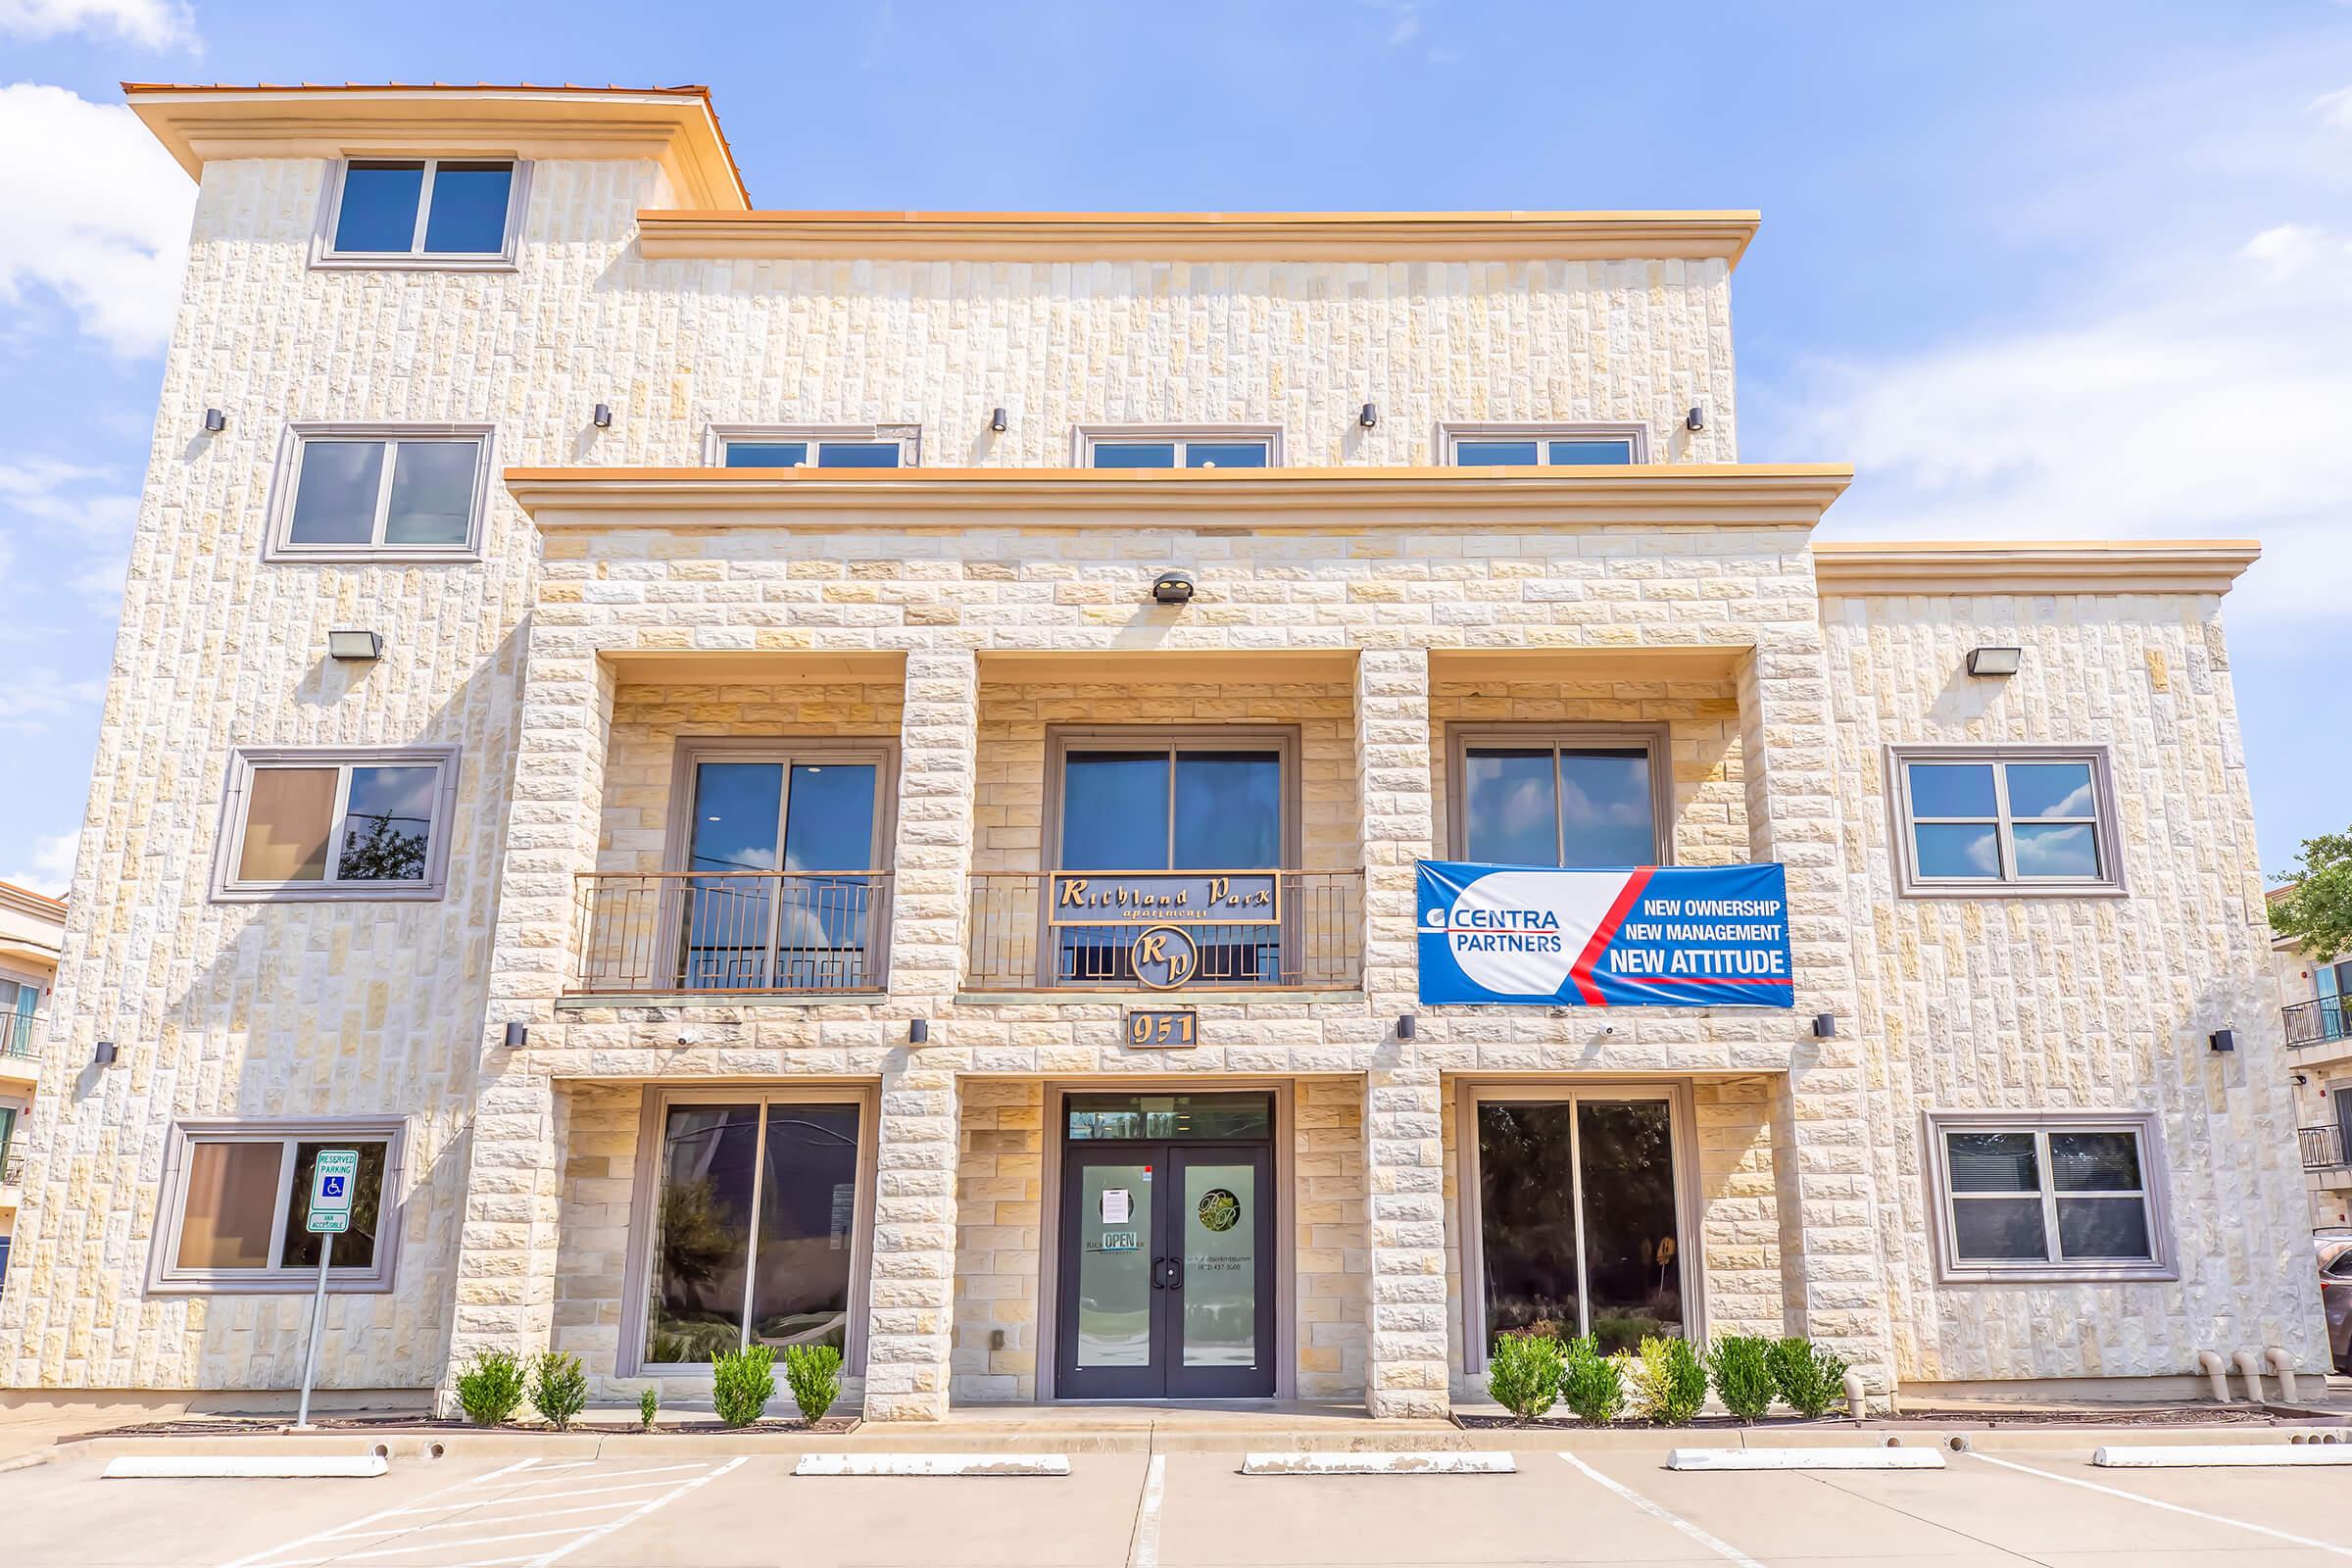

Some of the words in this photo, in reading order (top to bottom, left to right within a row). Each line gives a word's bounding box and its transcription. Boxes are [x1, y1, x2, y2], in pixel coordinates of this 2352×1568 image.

[1061, 879, 1188, 906] Richland
[1208, 877, 1271, 906] Park
[1644, 901, 1683, 916] NEW
[1685, 901, 1781, 917] OWNERSHIP
[1454, 908, 1560, 929] CENTRA
[1625, 924, 1667, 941] NEW
[1670, 924, 1782, 942] MANAGEMENT
[1457, 934, 1562, 953] PARTNERS
[1610, 951, 1667, 973] NEW
[1671, 950, 1785, 974] ATTITUDE
[1133, 1014, 1193, 1044] 951
[320, 1155, 354, 1164] RESERVED
[320, 1165, 351, 1174] PARKING
[1105, 1233, 1135, 1248] OPEN
